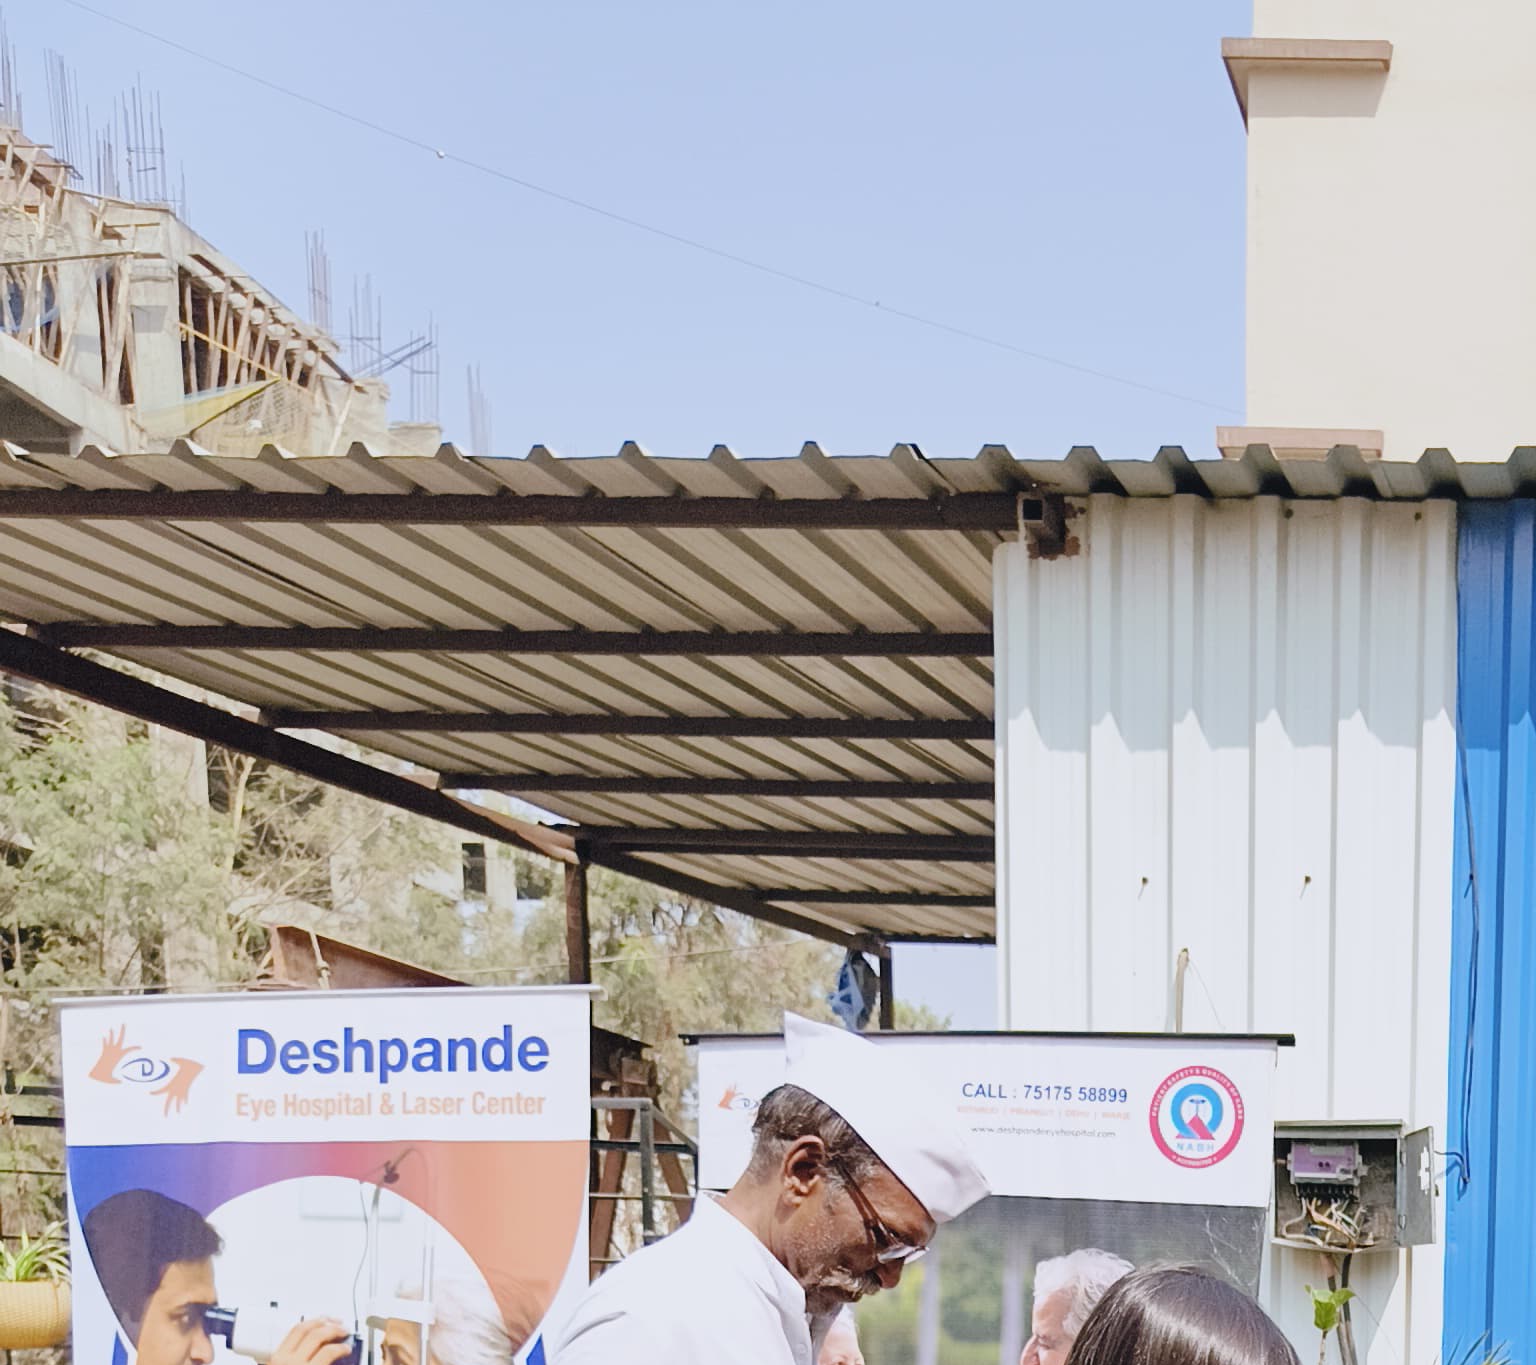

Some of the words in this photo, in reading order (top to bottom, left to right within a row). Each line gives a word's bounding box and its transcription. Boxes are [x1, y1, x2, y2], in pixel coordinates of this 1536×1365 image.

[236, 1025, 549, 1084] Deshpande
[236, 1095, 278, 1120] Eye
[284, 1094, 372, 1120] Hospital
[379, 1097, 395, 1115] &
[402, 1095, 463, 1116] Laser
[471, 1093, 546, 1116] Center
[962, 1083, 1007, 1099] CALL
[1023, 1085, 1073, 1102] 75175
[1078, 1087, 1128, 1103] 58899
